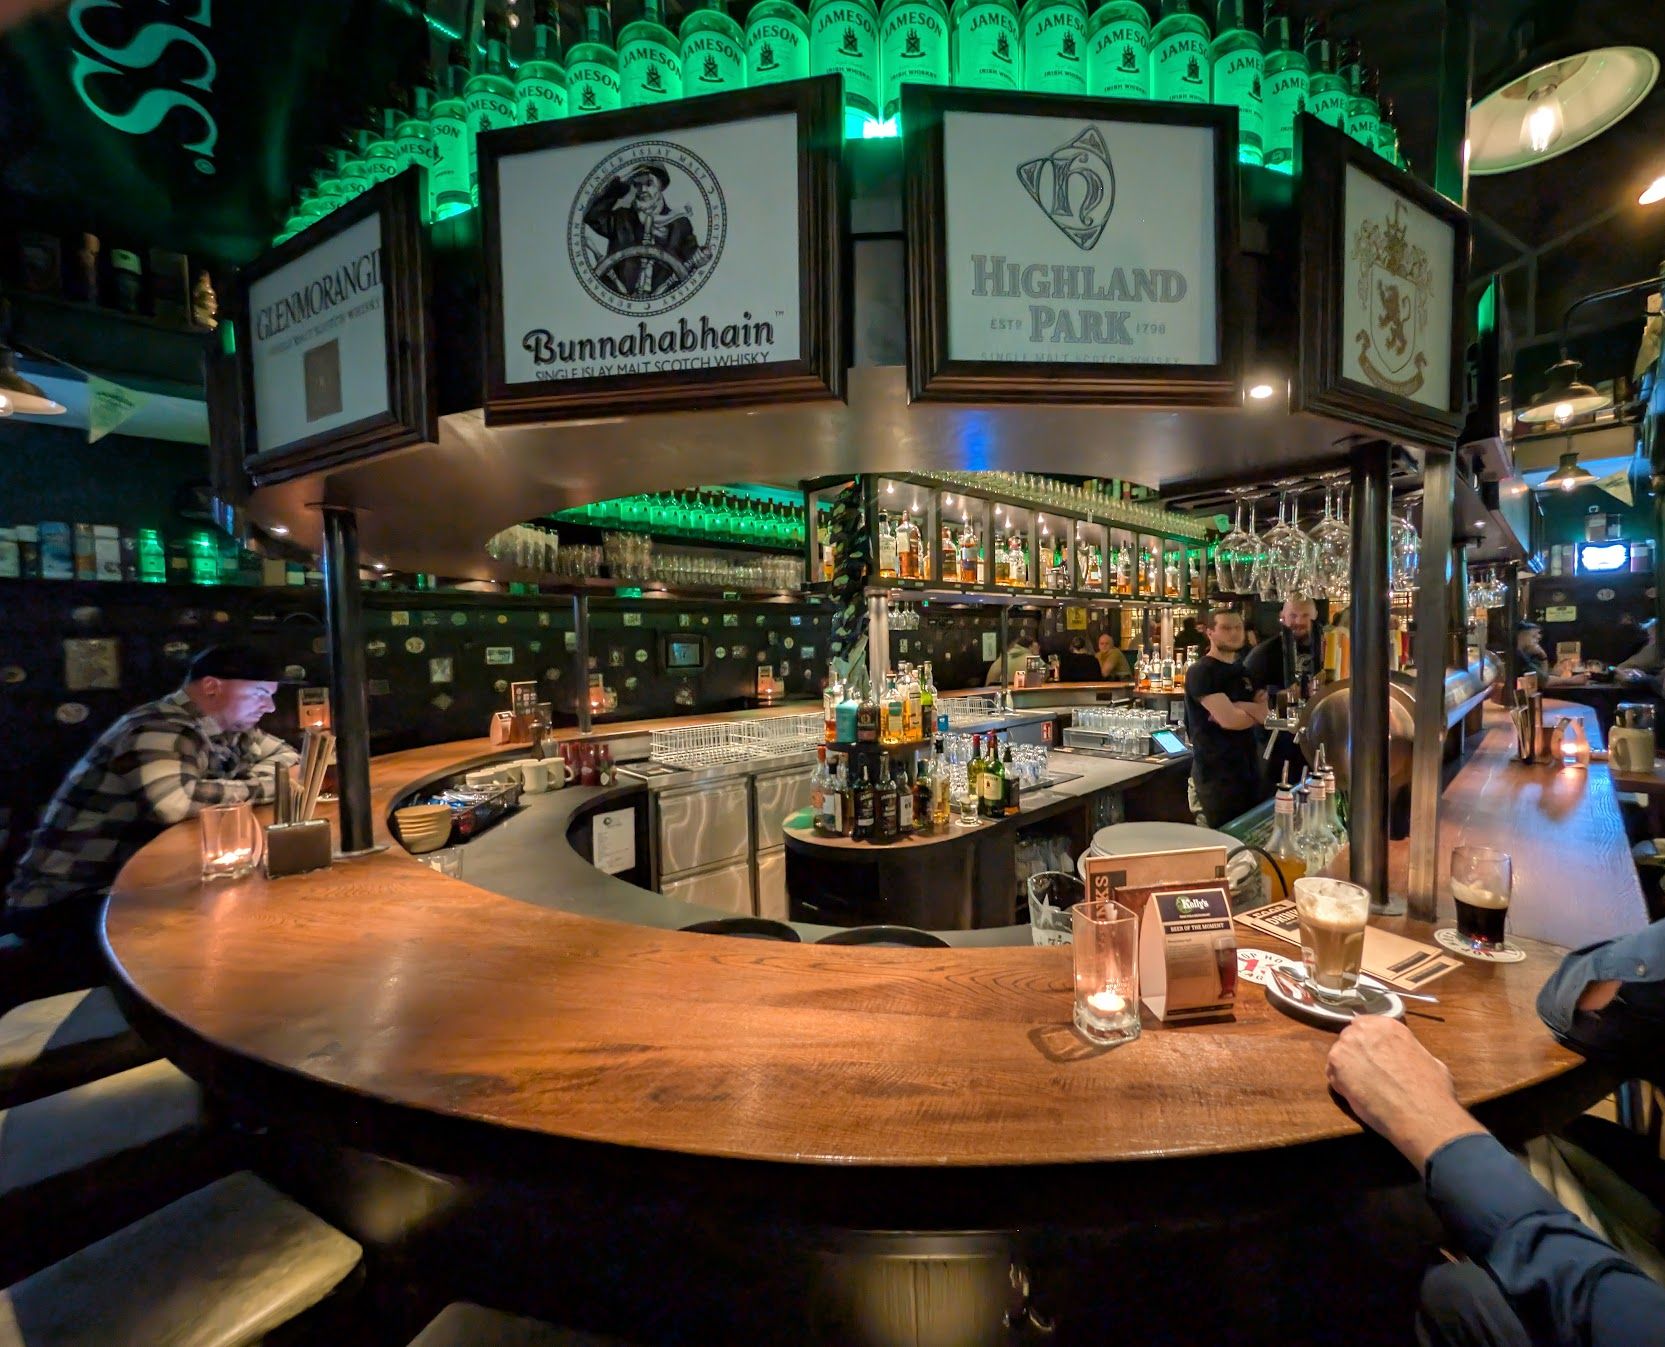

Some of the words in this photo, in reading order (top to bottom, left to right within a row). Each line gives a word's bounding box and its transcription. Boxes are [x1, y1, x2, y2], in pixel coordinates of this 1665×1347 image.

[256, 247, 382, 341] GLENMORANGI
[522, 310, 775, 366] Bunnahabhain
[1028, 305, 1134, 346] PARK
[713, 351, 770, 368] WHISKY
[1180, 898, 1210, 910] Kelly's
